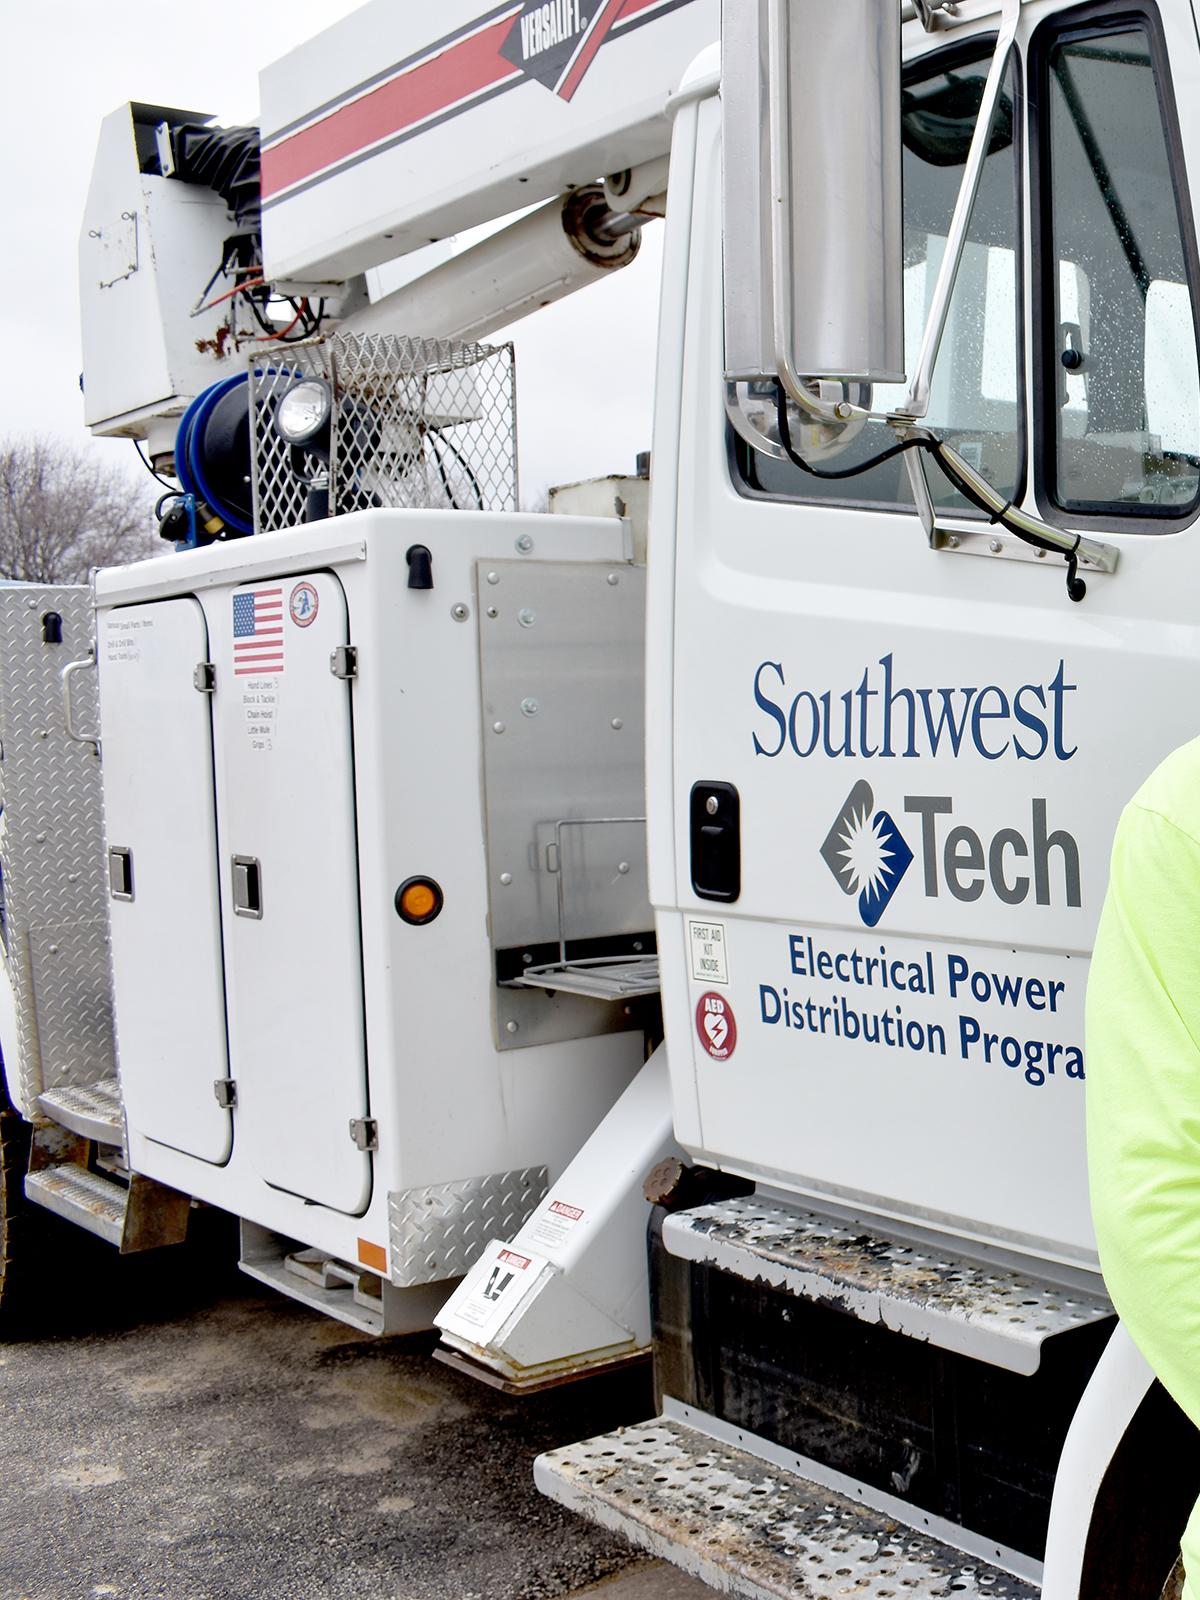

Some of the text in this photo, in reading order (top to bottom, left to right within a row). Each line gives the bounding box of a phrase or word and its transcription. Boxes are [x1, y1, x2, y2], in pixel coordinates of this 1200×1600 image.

[247, 681, 273, 689] Hand Lines
[243, 695, 255, 703] Block
[261, 694, 275, 703] Tackle
[752, 653, 1078, 760] Southwest
[247, 710, 260, 718] Chain
[260, 710, 273, 718] Hoist
[247, 726, 258, 734] Little
[252, 740, 265, 749] Grips
[904, 796, 1081, 907] Tech
[693, 927, 721, 942] FIRST AID
[703, 943, 713, 956] KIT
[700, 958, 719, 972] INSIDE
[789, 934, 1066, 1013] Electrical Power
[705, 998, 725, 1013] AED
[759, 983, 947, 1056] Distribution
[555, 1203, 581, 1219] DANGER
